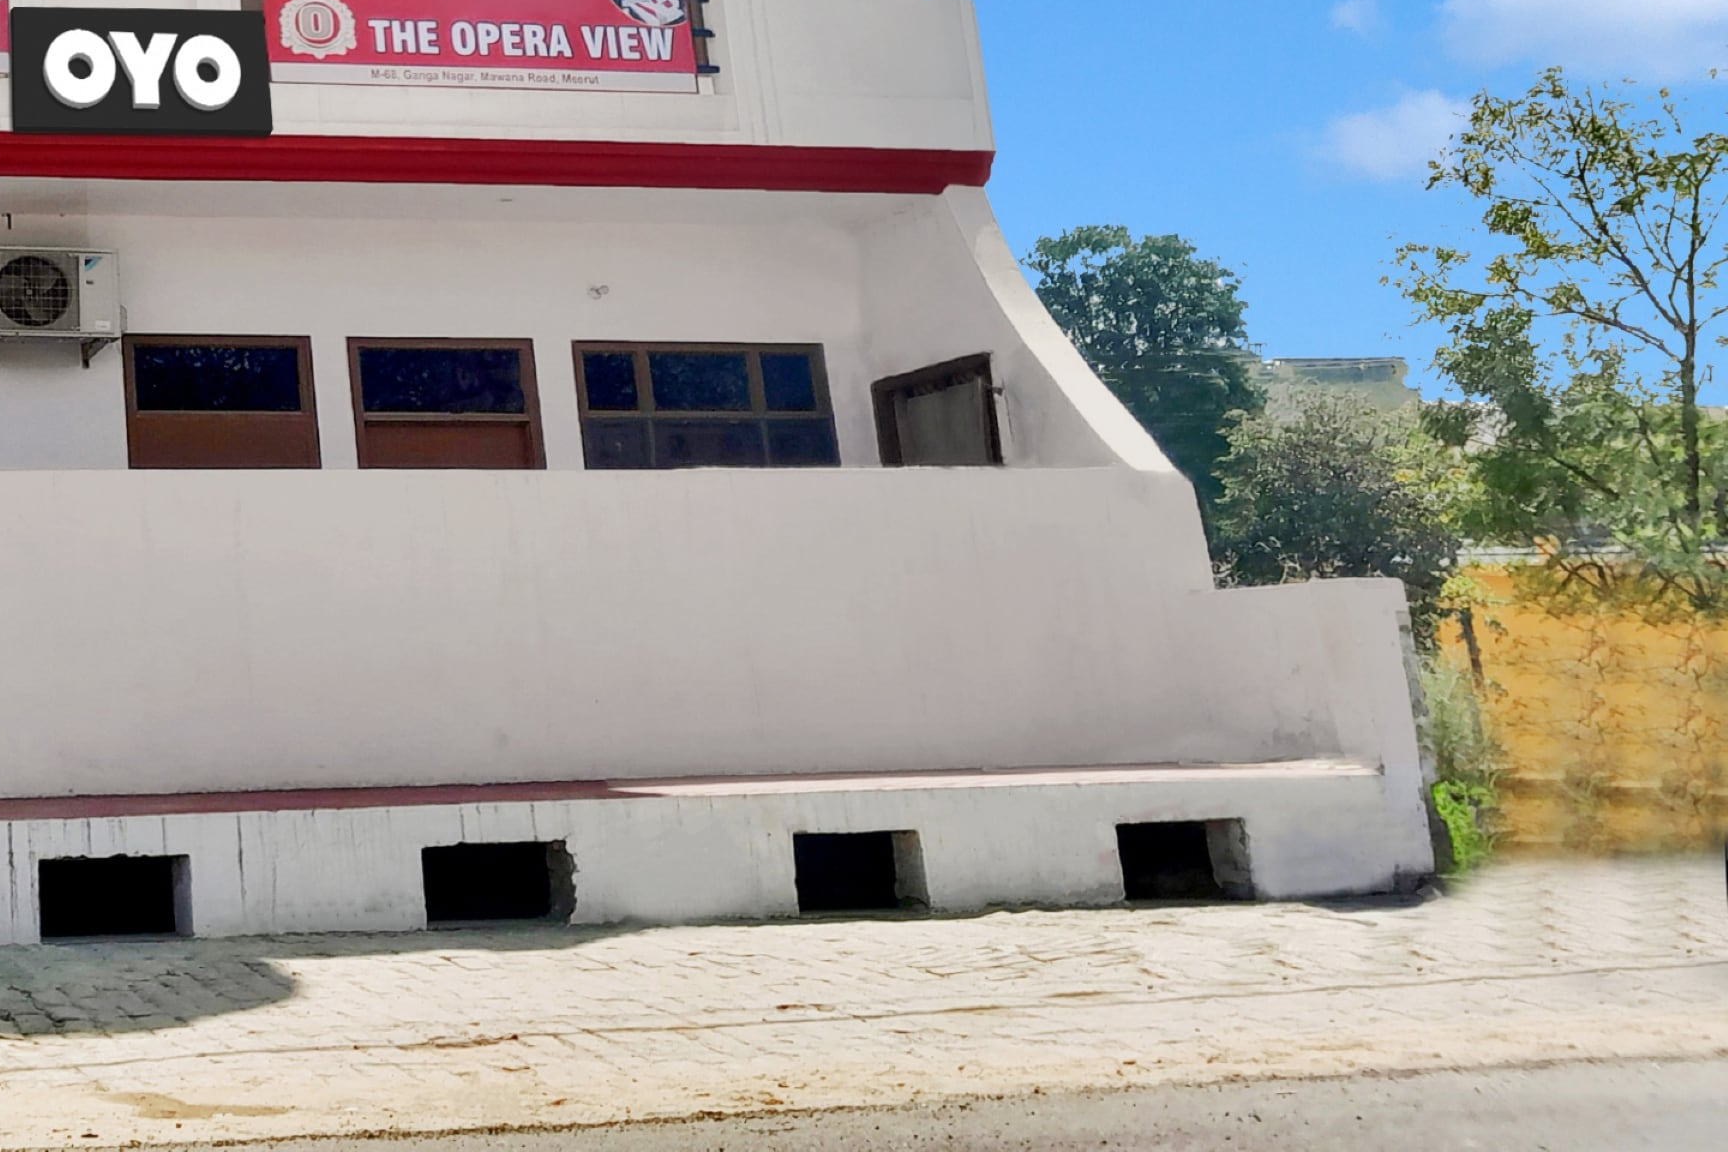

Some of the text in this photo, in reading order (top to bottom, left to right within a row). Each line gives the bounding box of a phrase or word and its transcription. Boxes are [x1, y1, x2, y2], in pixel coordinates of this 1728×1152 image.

[367, 19, 673, 61] THE OPERA VIEW
[43, 28, 241, 111] OYO
[403, 70, 439, 81] Ganga
[442, 71, 477, 82] Nagar,
[481, 72, 524, 82] Mawana
[528, 73, 560, 84] Road,
[562, 73, 599, 84] Meerut
